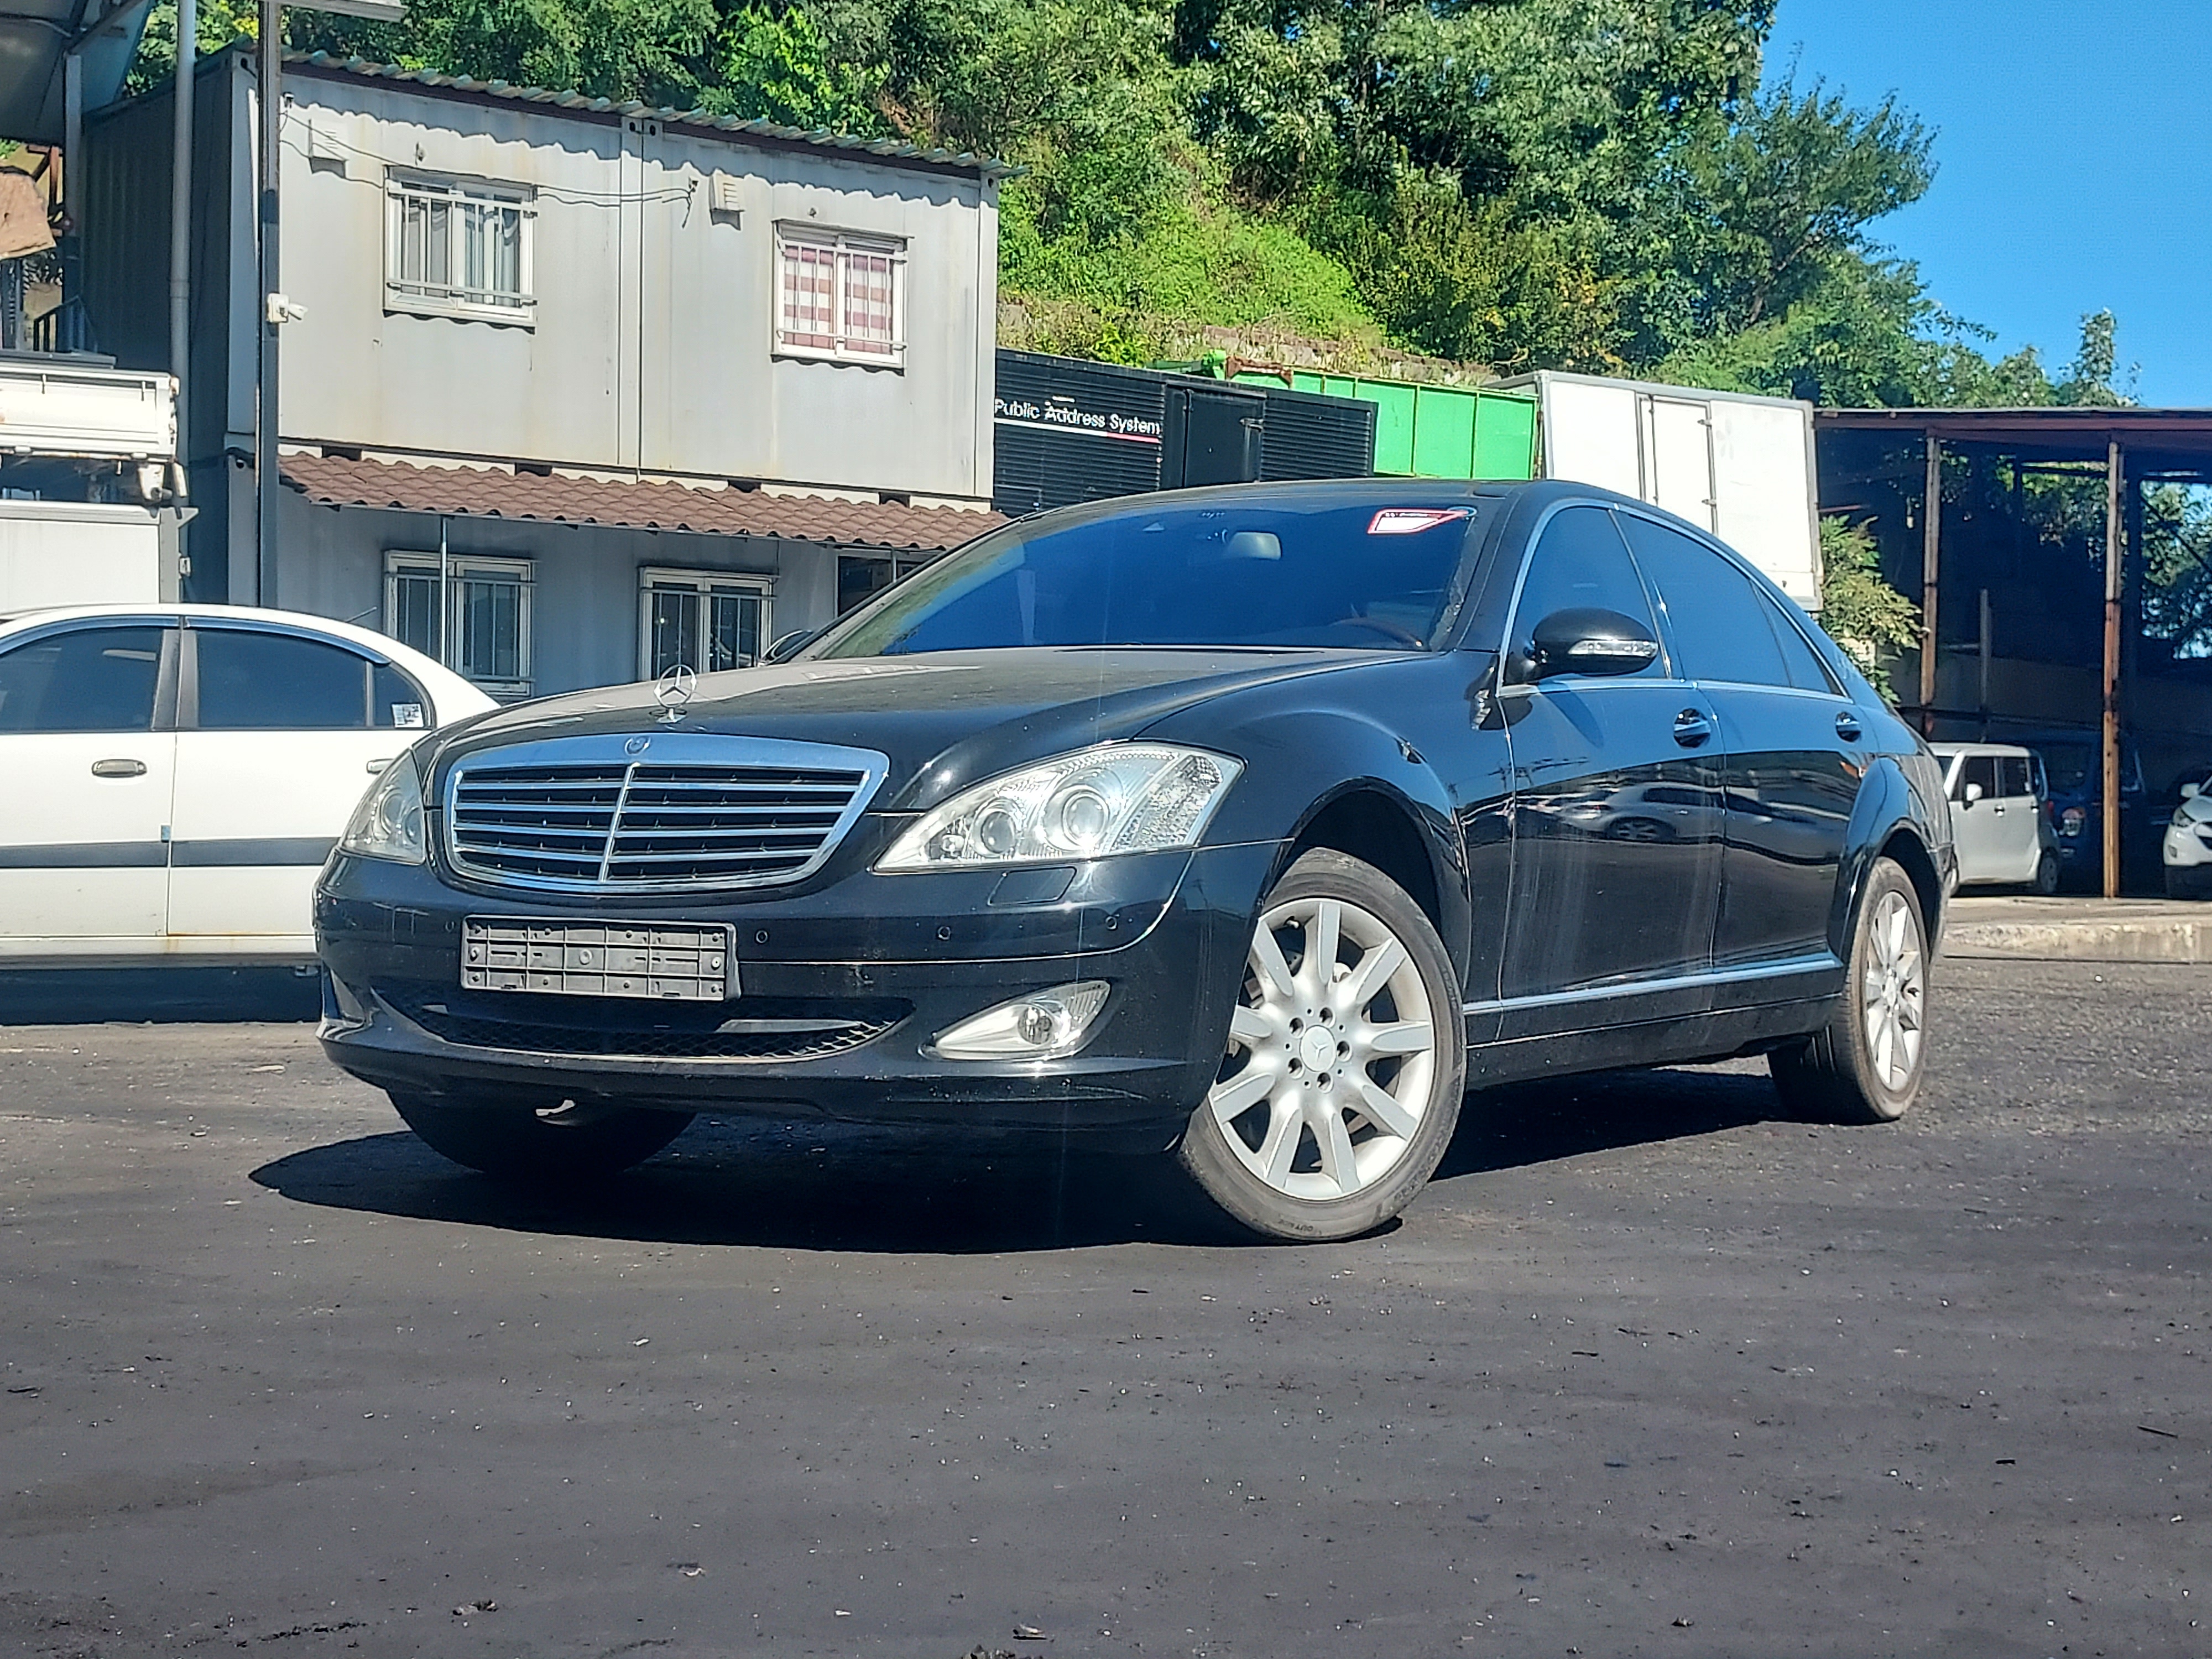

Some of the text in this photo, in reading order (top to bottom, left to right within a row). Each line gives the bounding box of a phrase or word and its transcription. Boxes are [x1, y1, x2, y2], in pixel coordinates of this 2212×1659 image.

[994, 398, 1160, 435] Public Address System
